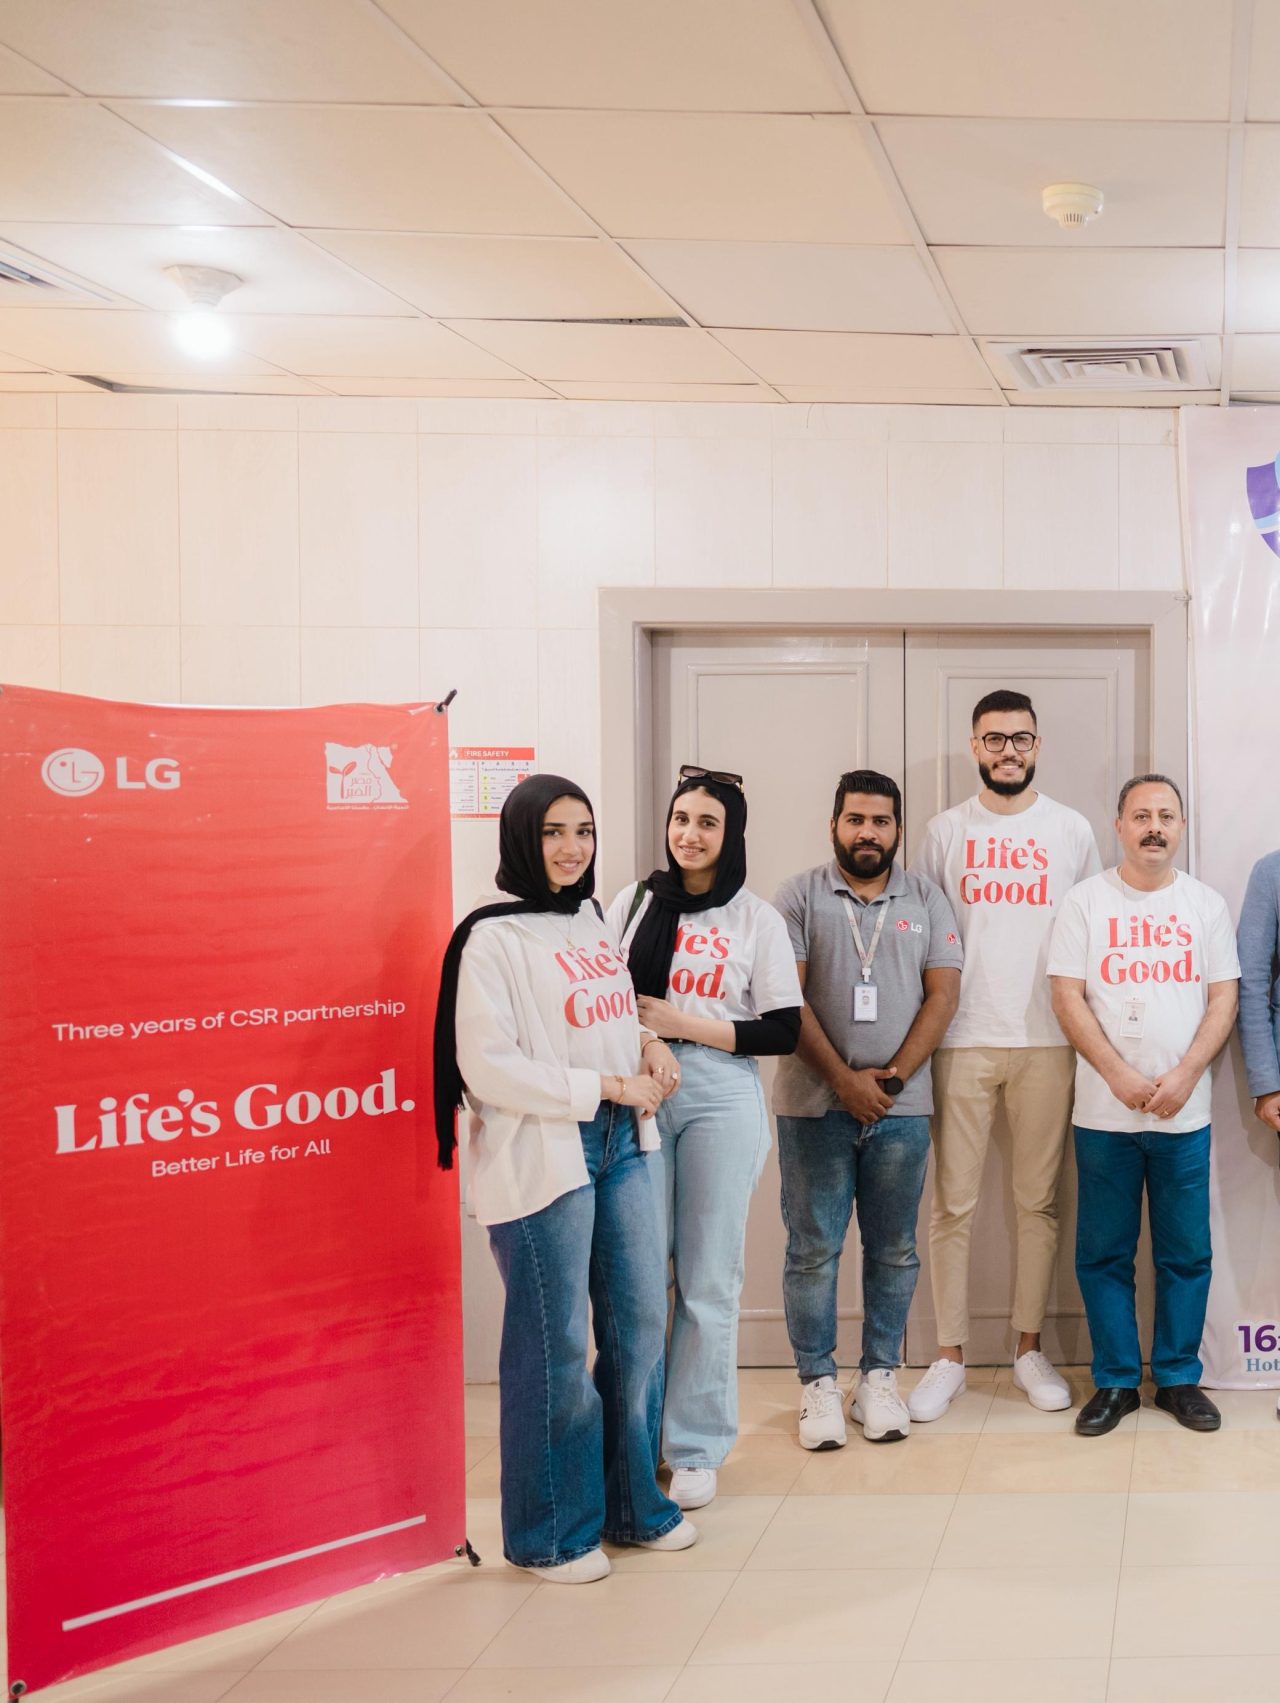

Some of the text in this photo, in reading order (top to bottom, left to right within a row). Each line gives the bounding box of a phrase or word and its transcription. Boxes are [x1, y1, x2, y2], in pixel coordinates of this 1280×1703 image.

[116, 756, 181, 790] LG
[674, 922, 731, 960] fe's
[910, 922, 922, 933] LG
[668, 964, 727, 1001] od.
[1100, 950, 1200, 985] Good.
[52, 999, 406, 1041] Three years of CSR partnership
[234, 1068, 415, 1130] Good.
[152, 1139, 331, 1178] Better Life for All
